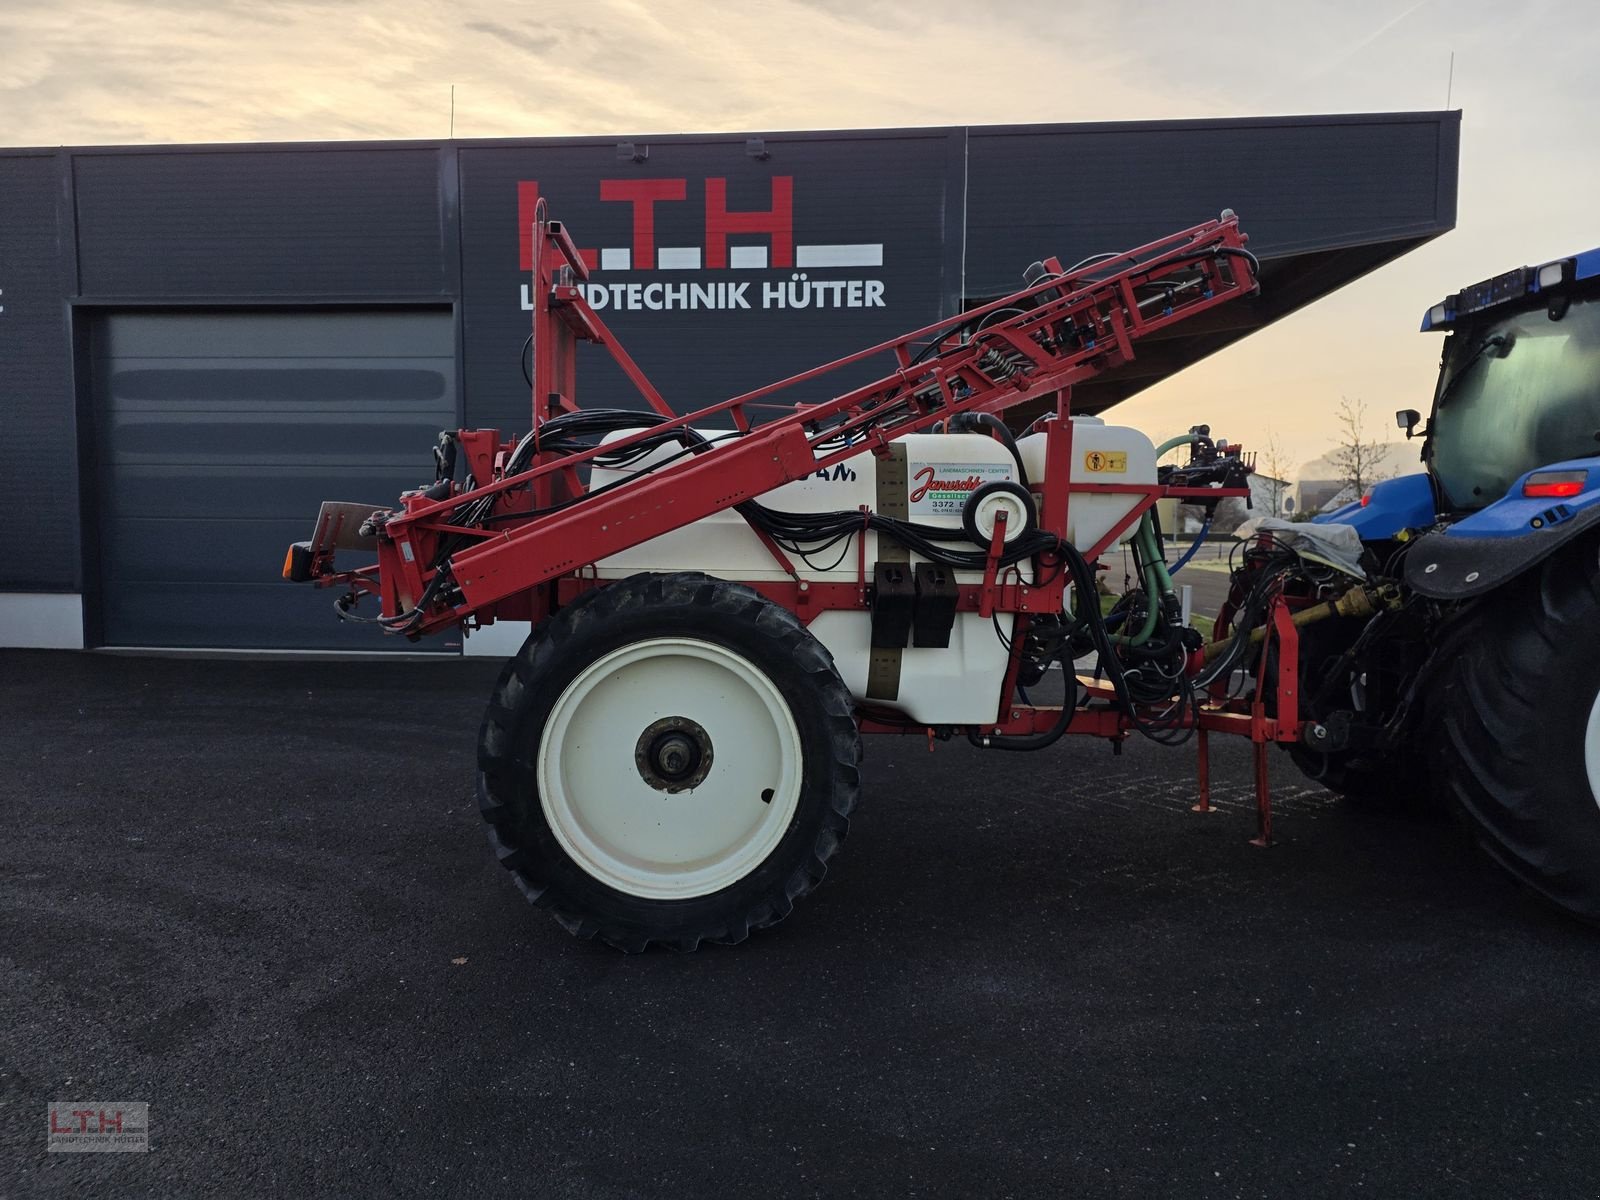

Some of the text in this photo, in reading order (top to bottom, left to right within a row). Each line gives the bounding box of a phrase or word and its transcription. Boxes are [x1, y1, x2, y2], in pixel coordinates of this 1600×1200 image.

[517, 175, 793, 270] LTH
[520, 272, 887, 311] LDTECHNIK HÜTTER
